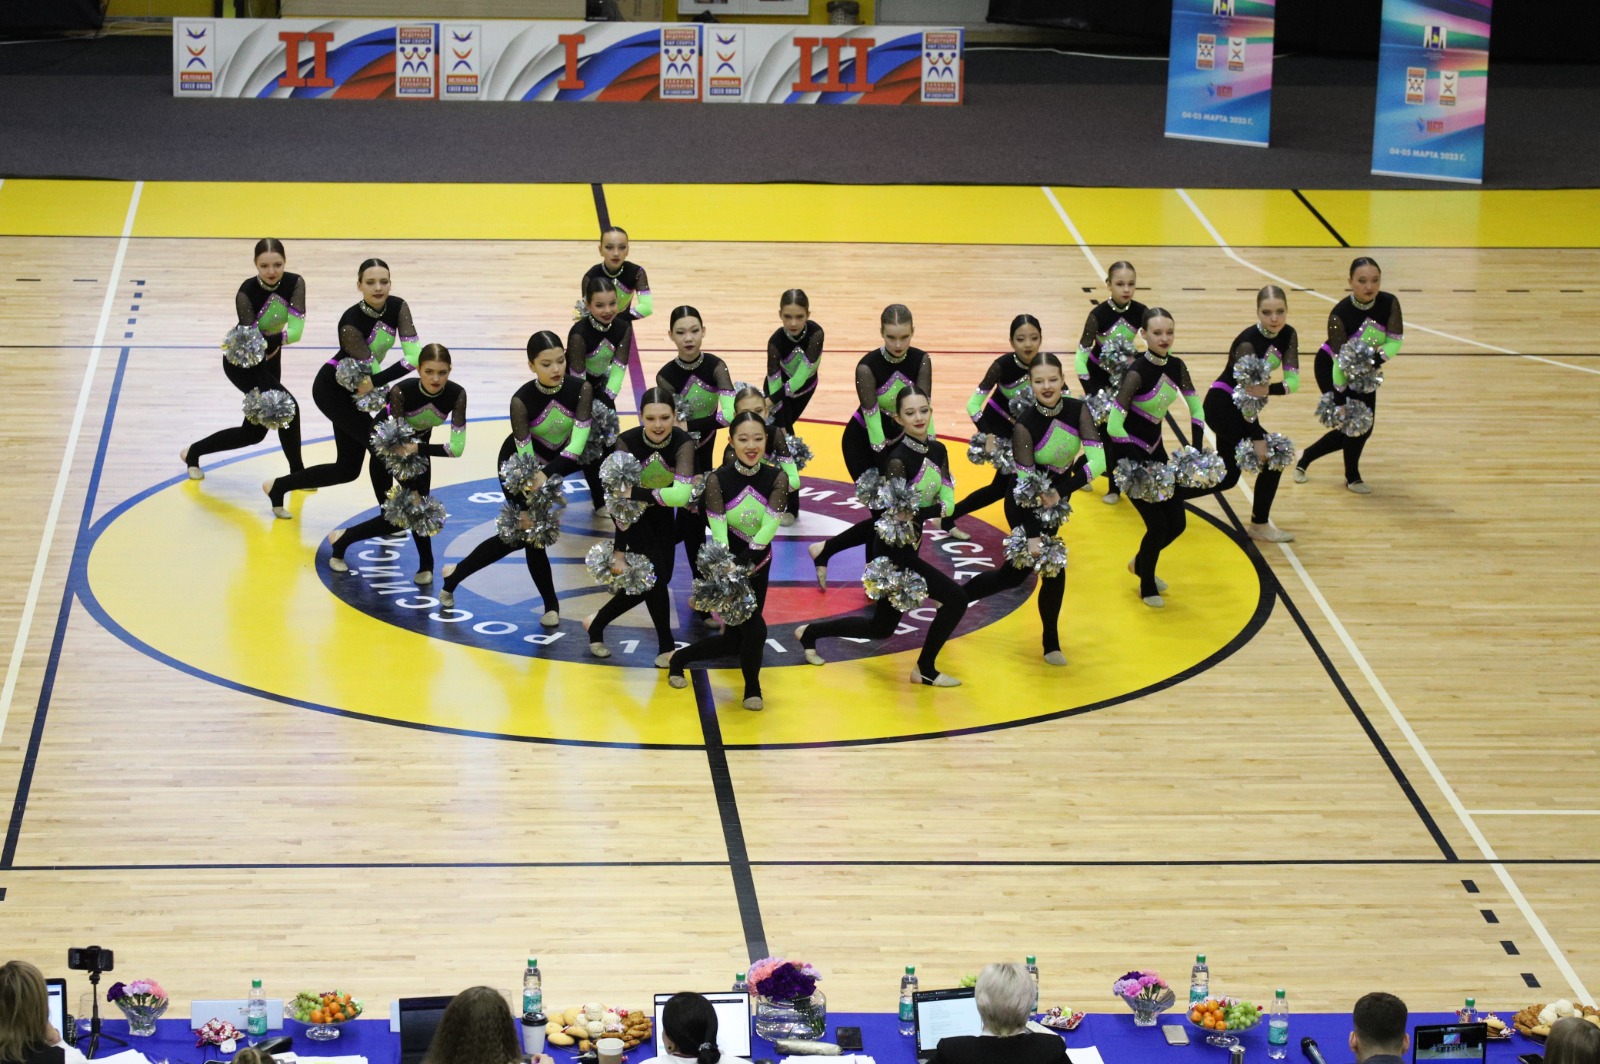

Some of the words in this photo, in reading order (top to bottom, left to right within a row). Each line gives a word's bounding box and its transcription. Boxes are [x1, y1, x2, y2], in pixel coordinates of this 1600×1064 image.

[1203, 113, 1228, 123] МАРТА
[1412, 149, 1438, 159] МАРТА
[348, 513, 567, 646] РОССИЙСК
